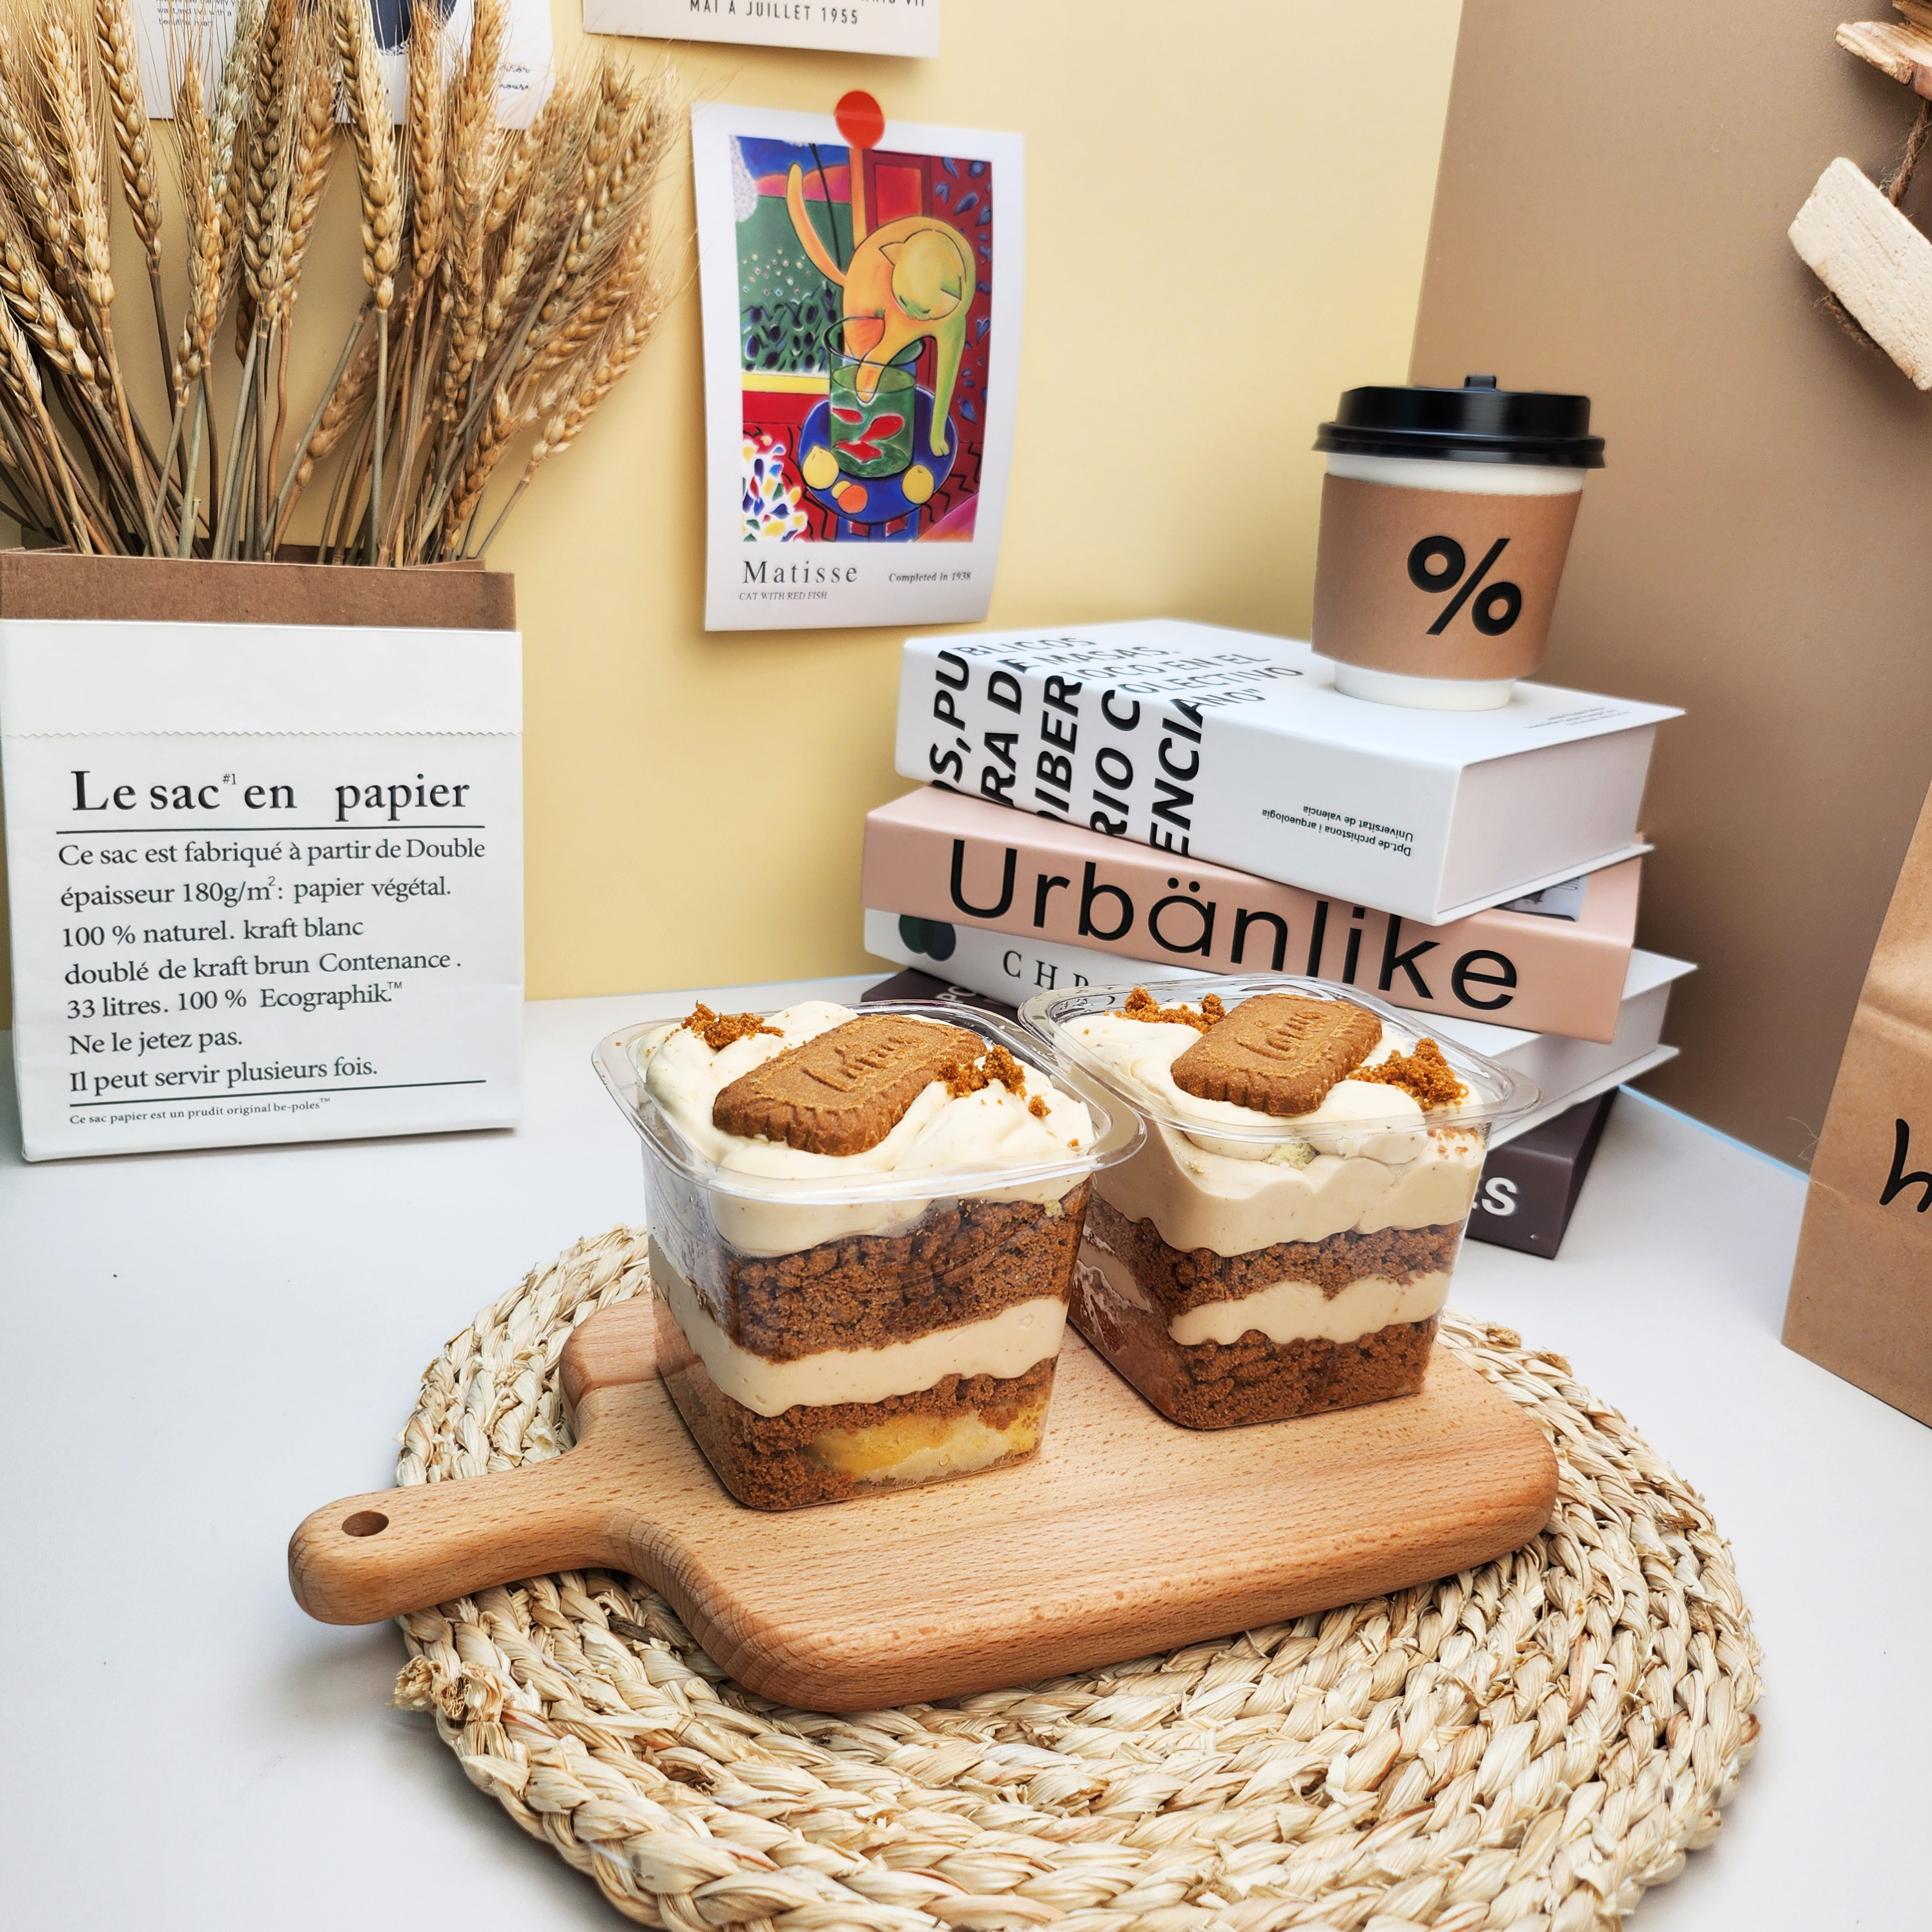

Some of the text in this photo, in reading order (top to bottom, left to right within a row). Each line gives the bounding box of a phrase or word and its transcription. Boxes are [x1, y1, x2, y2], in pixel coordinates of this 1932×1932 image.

[745, 1, 812, 21] JUILLET
[821, 7, 858, 25] 1955
[743, 560, 857, 584] Matisse
[889, 571, 972, 584] Completed in 1938
[739, 591, 828, 601] CAT WITH RED FISH
[70, 770, 137, 811] Le
[150, 785, 220, 810] sac
[244, 785, 298, 810] en
[334, 773, 470, 823] papier
[1262, 808, 1318, 830] arqueologia
[1302, 806, 1413, 843] Universitat de valencia
[1318, 824, 1322, 834] i
[58, 838, 486, 868] Ce sac est fabriqué à partir de Double
[60, 885, 176, 913] épaisseur
[293, 877, 365, 904] papier
[371, 876, 451, 903] végétal.
[63, 916, 364, 947] 100 % naturel. kraft blanc
[948, 838, 1518, 1011] Urbänlike
[64, 960, 149, 985] doublé
[158, 958, 187, 980] de
[192, 955, 250, 978] kraft
[254, 954, 311, 975] brun
[319, 952, 451, 972] Contenance
[67, 999, 96, 1020] 33
[101, 996, 169, 1018] litres.
[178, 990, 218, 1011] 100
[225, 989, 247, 1009] %
[68, 1031, 243, 1057] Ne le jetez pas.
[69, 1056, 378, 1097] Il peut servir plusieurs fois.
[69, 1115, 86, 1124] Ce
[110, 1113, 148, 1125] papier
[150, 1111, 166, 1120] est
[188, 1106, 223, 1120] prudit
[227, 1103, 271, 1116] original
